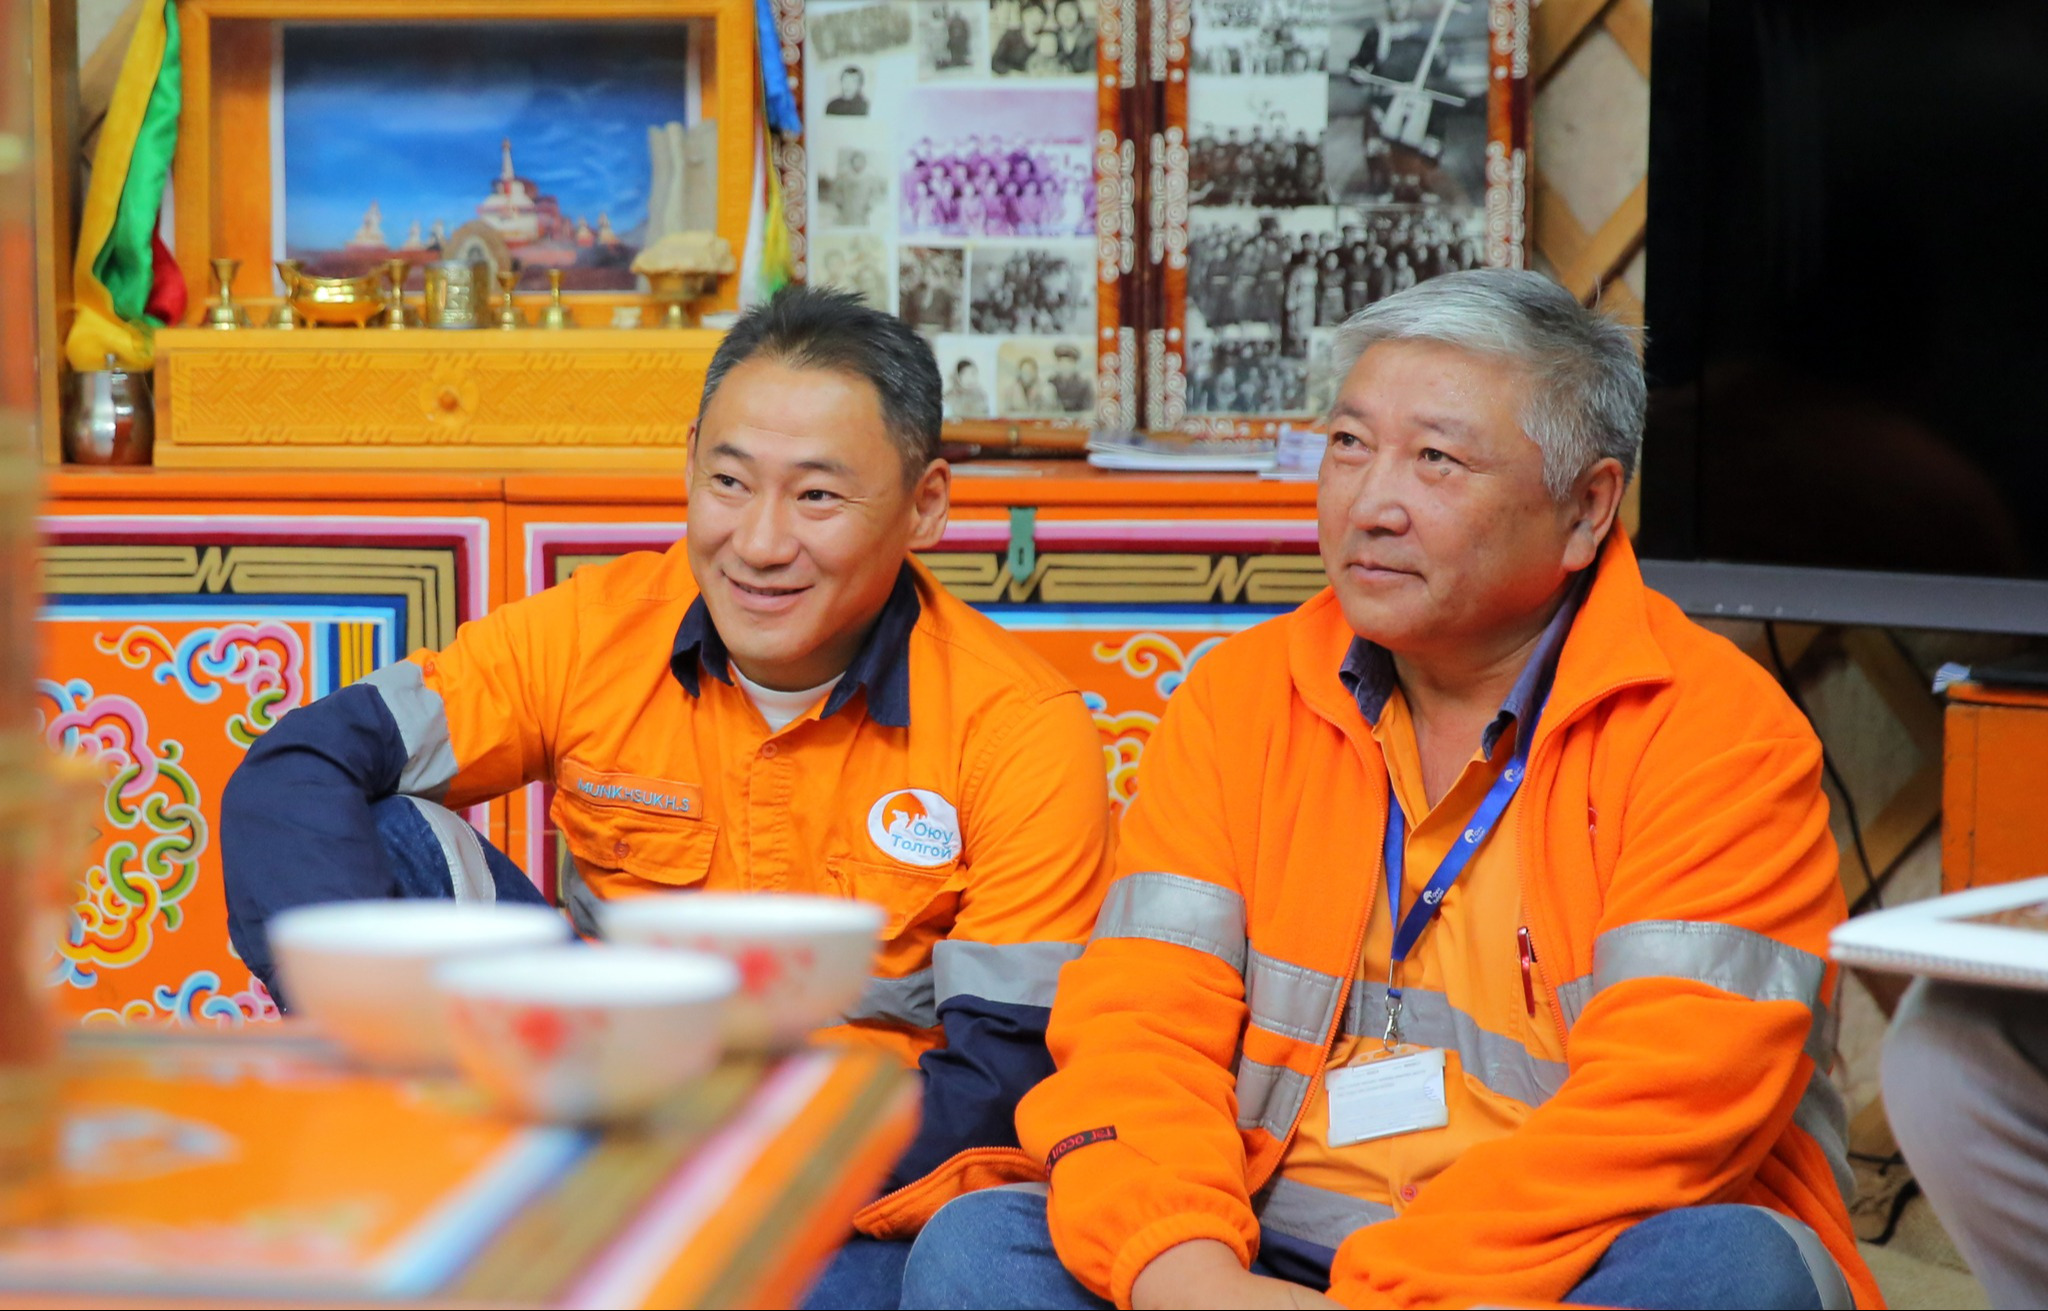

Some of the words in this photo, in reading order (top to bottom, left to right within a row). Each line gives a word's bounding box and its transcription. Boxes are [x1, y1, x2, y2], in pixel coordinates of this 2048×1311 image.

[577, 778, 689, 812] MUNKHSUKH.S
[913, 822, 954, 845] Оюу
[891, 834, 952, 859] Толгой
